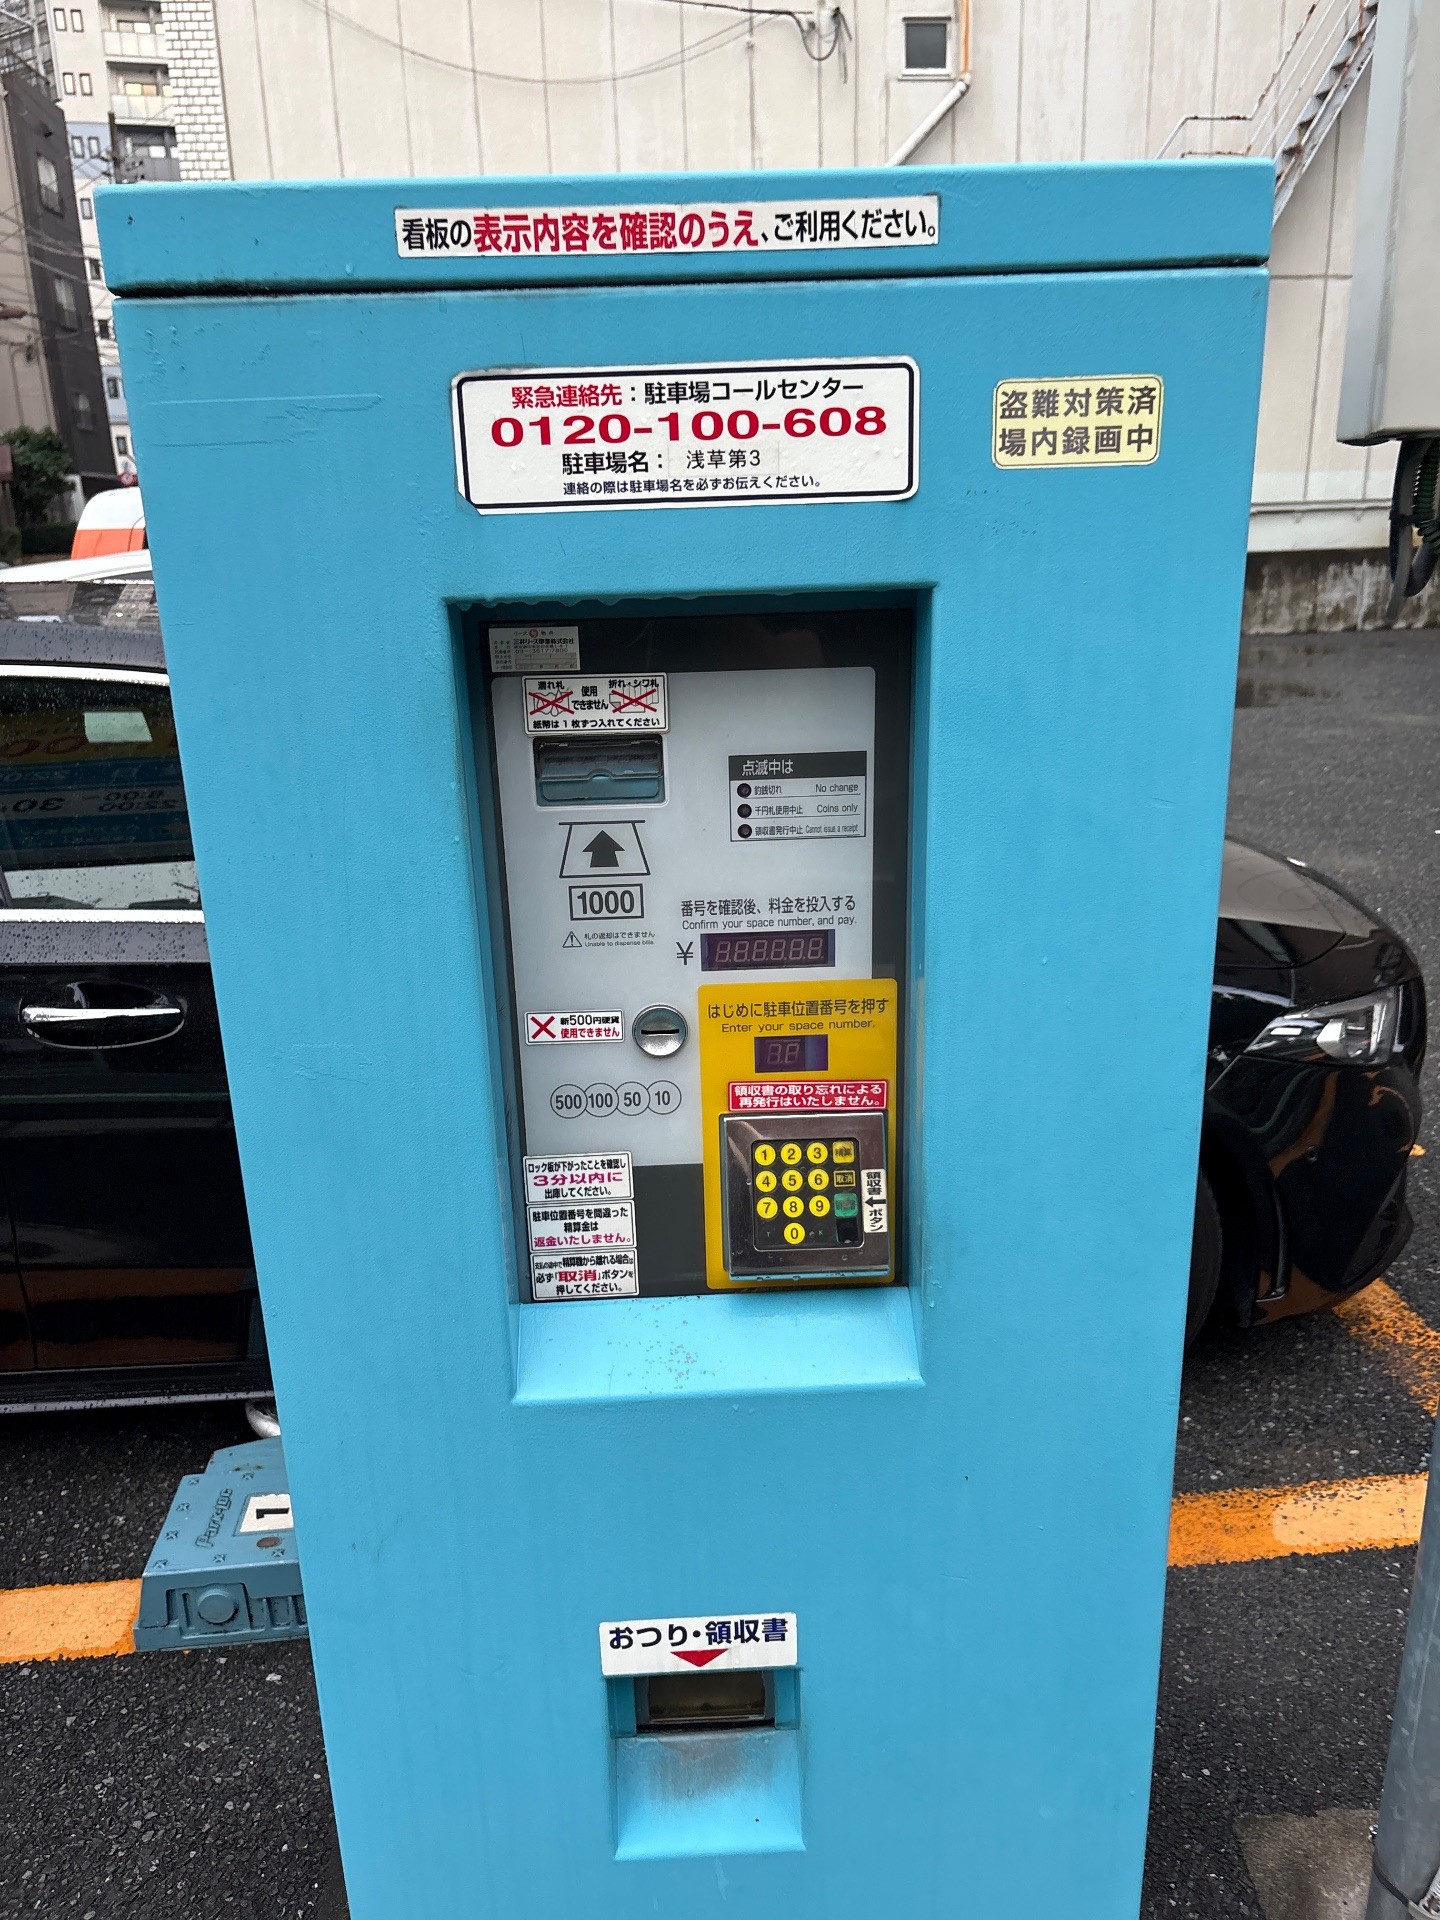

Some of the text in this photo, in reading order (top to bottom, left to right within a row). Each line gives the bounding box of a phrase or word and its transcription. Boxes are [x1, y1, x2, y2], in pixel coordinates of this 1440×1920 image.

[402, 209, 937, 253] 看板の表示内容を確認のうえ、ご利用ください。
[999, 385, 1156, 419] 盗難対策済
[490, 407, 888, 447] 0120-100-608
[998, 424, 1153, 457] 場内録画中
[685, 448, 761, 469] 浅草第3
[563, 475, 821, 496] 連絡の際は駐車場名を必ずお伝えください。
[608, 678, 660, 689] 折れ・シワ札
[581, 685, 598, 697] 使用
[571, 700, 609, 711] できません
[742, 759, 794, 777] 点滅中は
[753, 785, 782, 795] 釣銭切れ
[815, 783, 859, 793] No change
[754, 805, 803, 816] 千円札使用中止
[816, 803, 859, 814] Coins only
[755, 825, 804, 836] 領収書発行中止
[805, 825, 822, 834] Cannot
[577, 889, 635, 915] 1000
[681, 895, 856, 917] 番号を確認後、料金を投入する
[682, 915, 858, 930] Confirm your space number, and pay.
[708, 998, 889, 1019] はじめに駐車位置番号を押す
[560, 1014, 620, 1025] 新500円硬貨
[721, 1019, 876, 1033] Enter your space number.
[560, 1027, 620, 1039] 使用できません
[734, 1084, 882, 1097] 領収書の取り忘れによる
[555, 1094, 582, 1110] 500
[588, 1092, 613, 1108] 100
[623, 1091, 641, 1107] 50
[654, 1090, 671, 1106] 10
[739, 1095, 881, 1109] 再発行はいたしません。
[761, 1149, 768, 1161] 1
[787, 1148, 796, 1160] 2
[813, 1148, 822, 1159] 3
[533, 1172, 623, 1187] 3分以内に
[761, 1175, 771, 1187] 4
[788, 1174, 797, 1187] 5
[814, 1174, 823, 1186] 6
[836, 1173, 853, 1186] 取消
[866, 1171, 882, 1196] 領収書
[544, 1186, 612, 1199] 出庫してください。
[763, 1201, 772, 1214] 7
[789, 1201, 798, 1213] 8
[815, 1200, 824, 1212] 9
[868, 1208, 883, 1232] ボタン
[790, 1227, 799, 1240] 0
[534, 1233, 631, 1248] 返金いたしません。
[556, 1283, 622, 1296] 押してください。
[255, 1507, 290, 1520] 1
[608, 1617, 789, 1650] おつり・領収書
